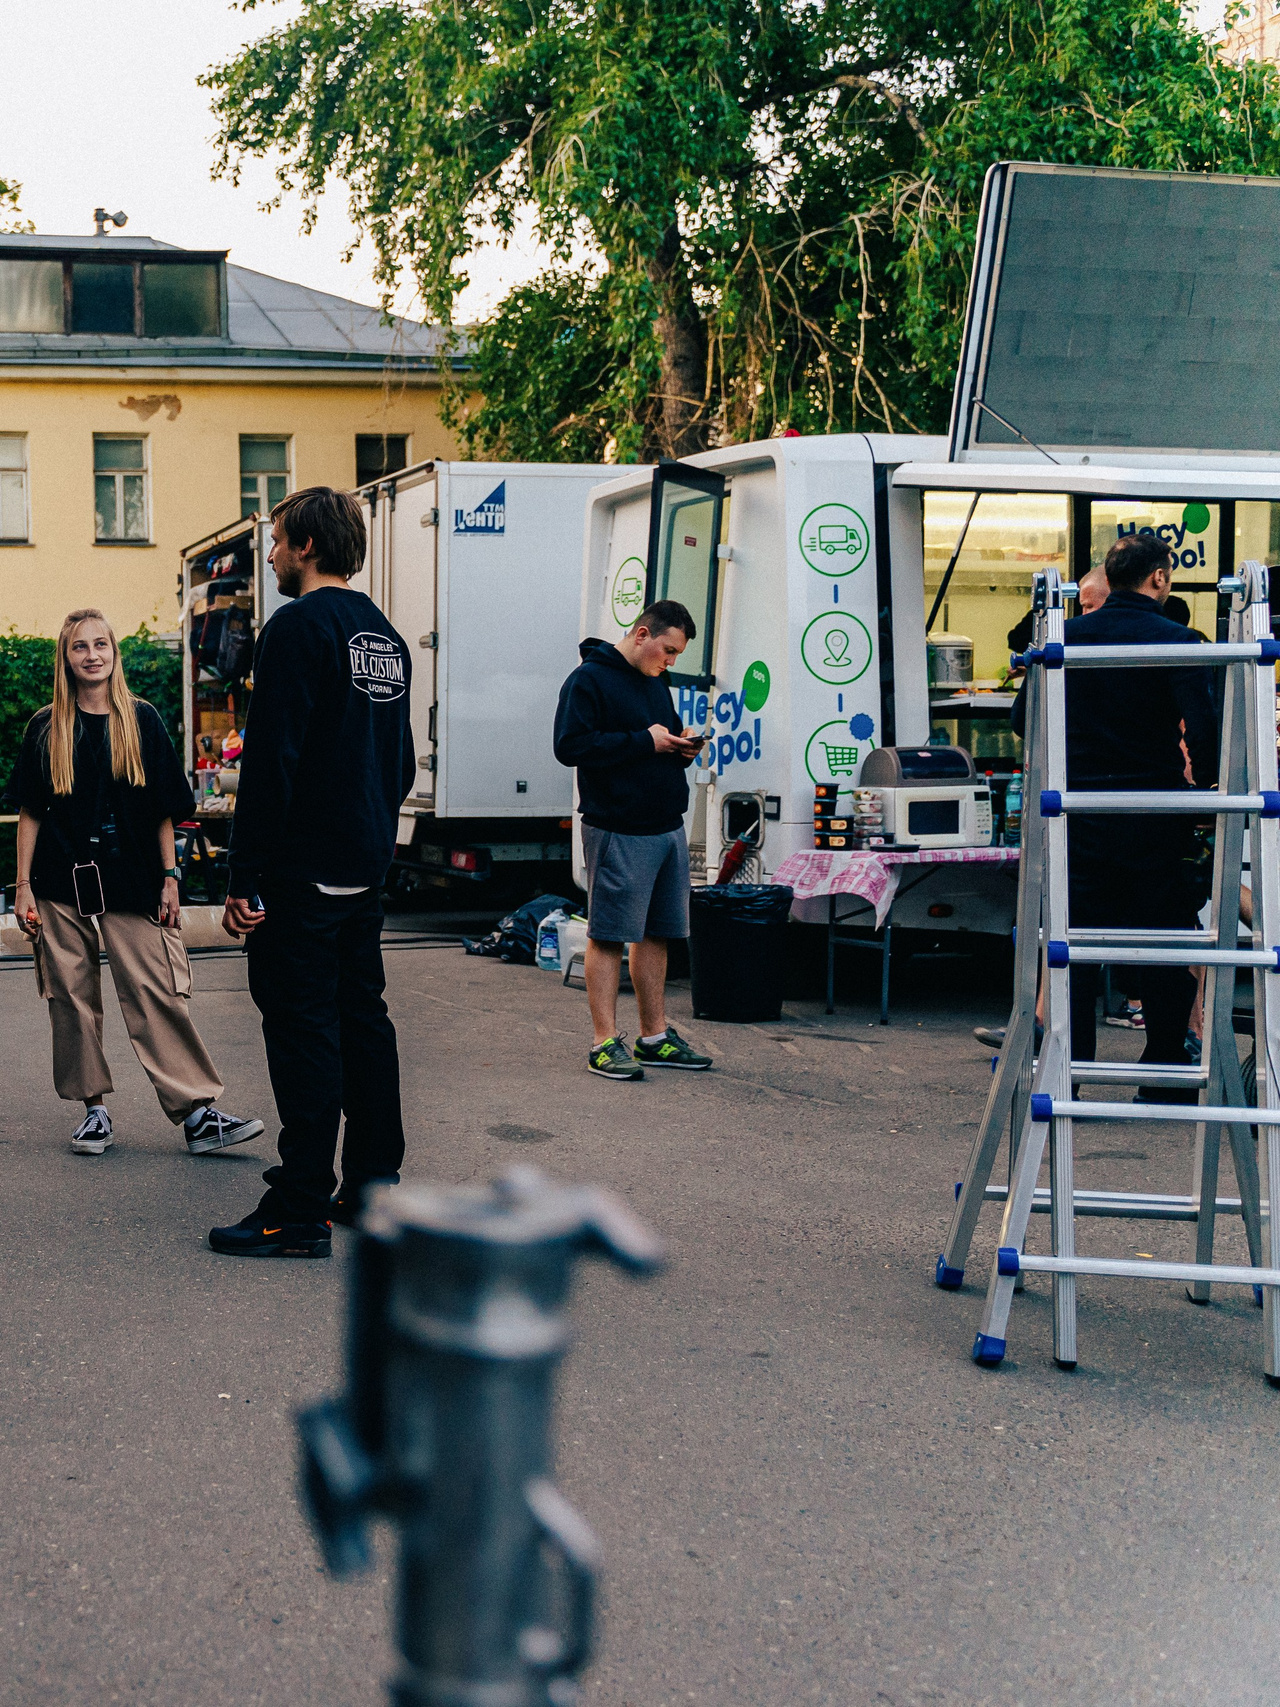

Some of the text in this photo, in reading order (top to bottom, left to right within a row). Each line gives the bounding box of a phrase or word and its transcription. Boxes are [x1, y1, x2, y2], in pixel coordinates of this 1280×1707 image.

[454, 509, 505, 530] Центр
[360, 637, 394, 652] LS ANGELES
[350, 648, 405, 681] DEU CUSTOM
